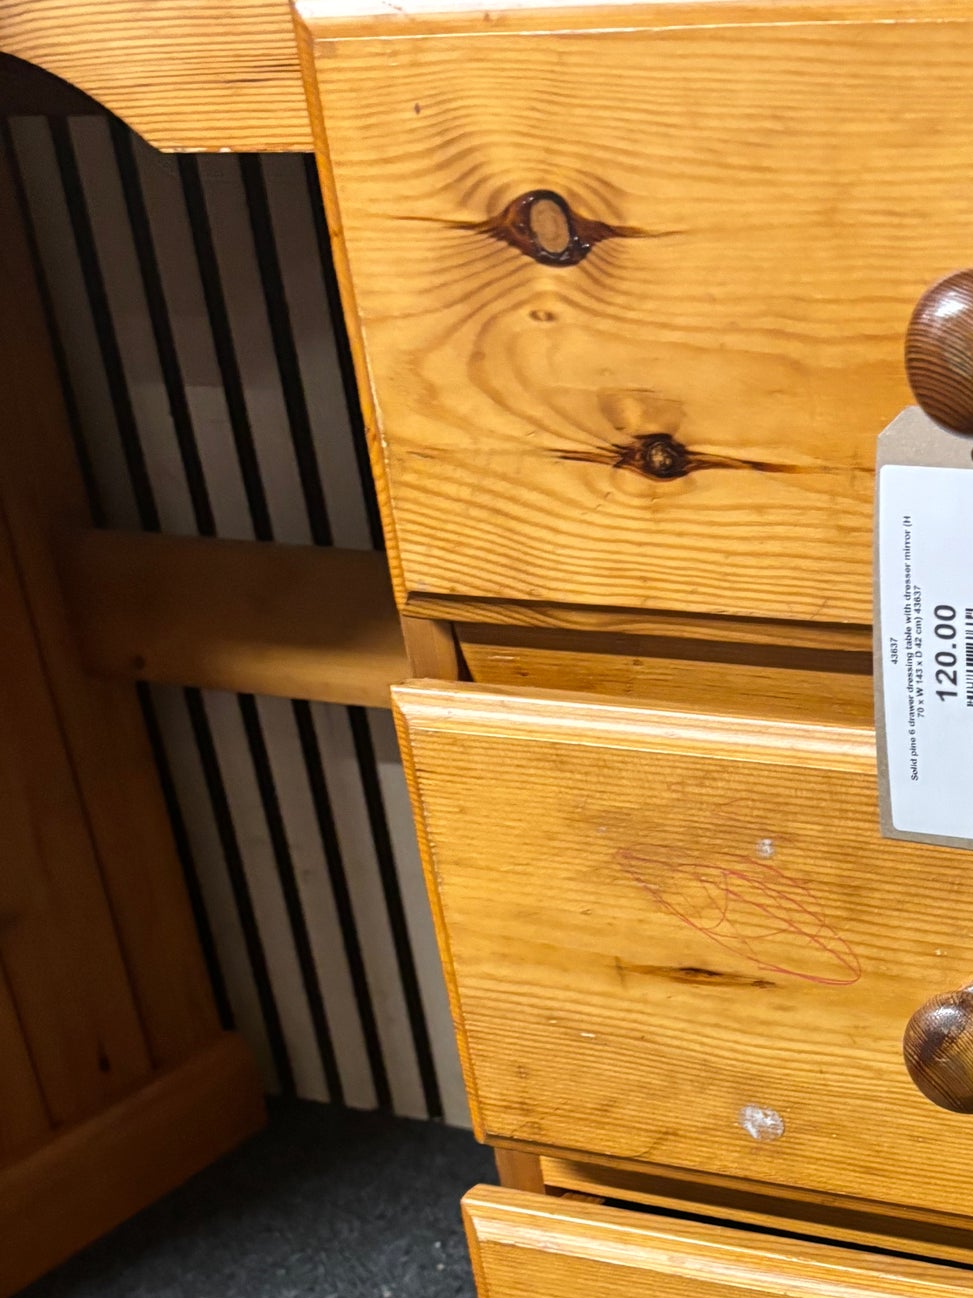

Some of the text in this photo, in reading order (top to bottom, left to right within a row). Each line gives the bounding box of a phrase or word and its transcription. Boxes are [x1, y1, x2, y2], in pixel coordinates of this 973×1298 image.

[902, 529, 911, 561] mirror
[902, 562, 912, 601] dresser
[903, 603, 912, 624] with
[914, 616, 923, 635] cm)
[904, 626, 913, 650] table
[914, 637, 923, 649] 42
[933, 604, 958, 702] 120.00
[905, 652, 916, 693] dressing
[915, 668, 924, 684] 143
[916, 686, 924, 697] W
[906, 695, 916, 727] drawer
[917, 707, 925, 718] 70
[909, 737, 919, 757] pine
[909, 758, 919, 781] Solid
